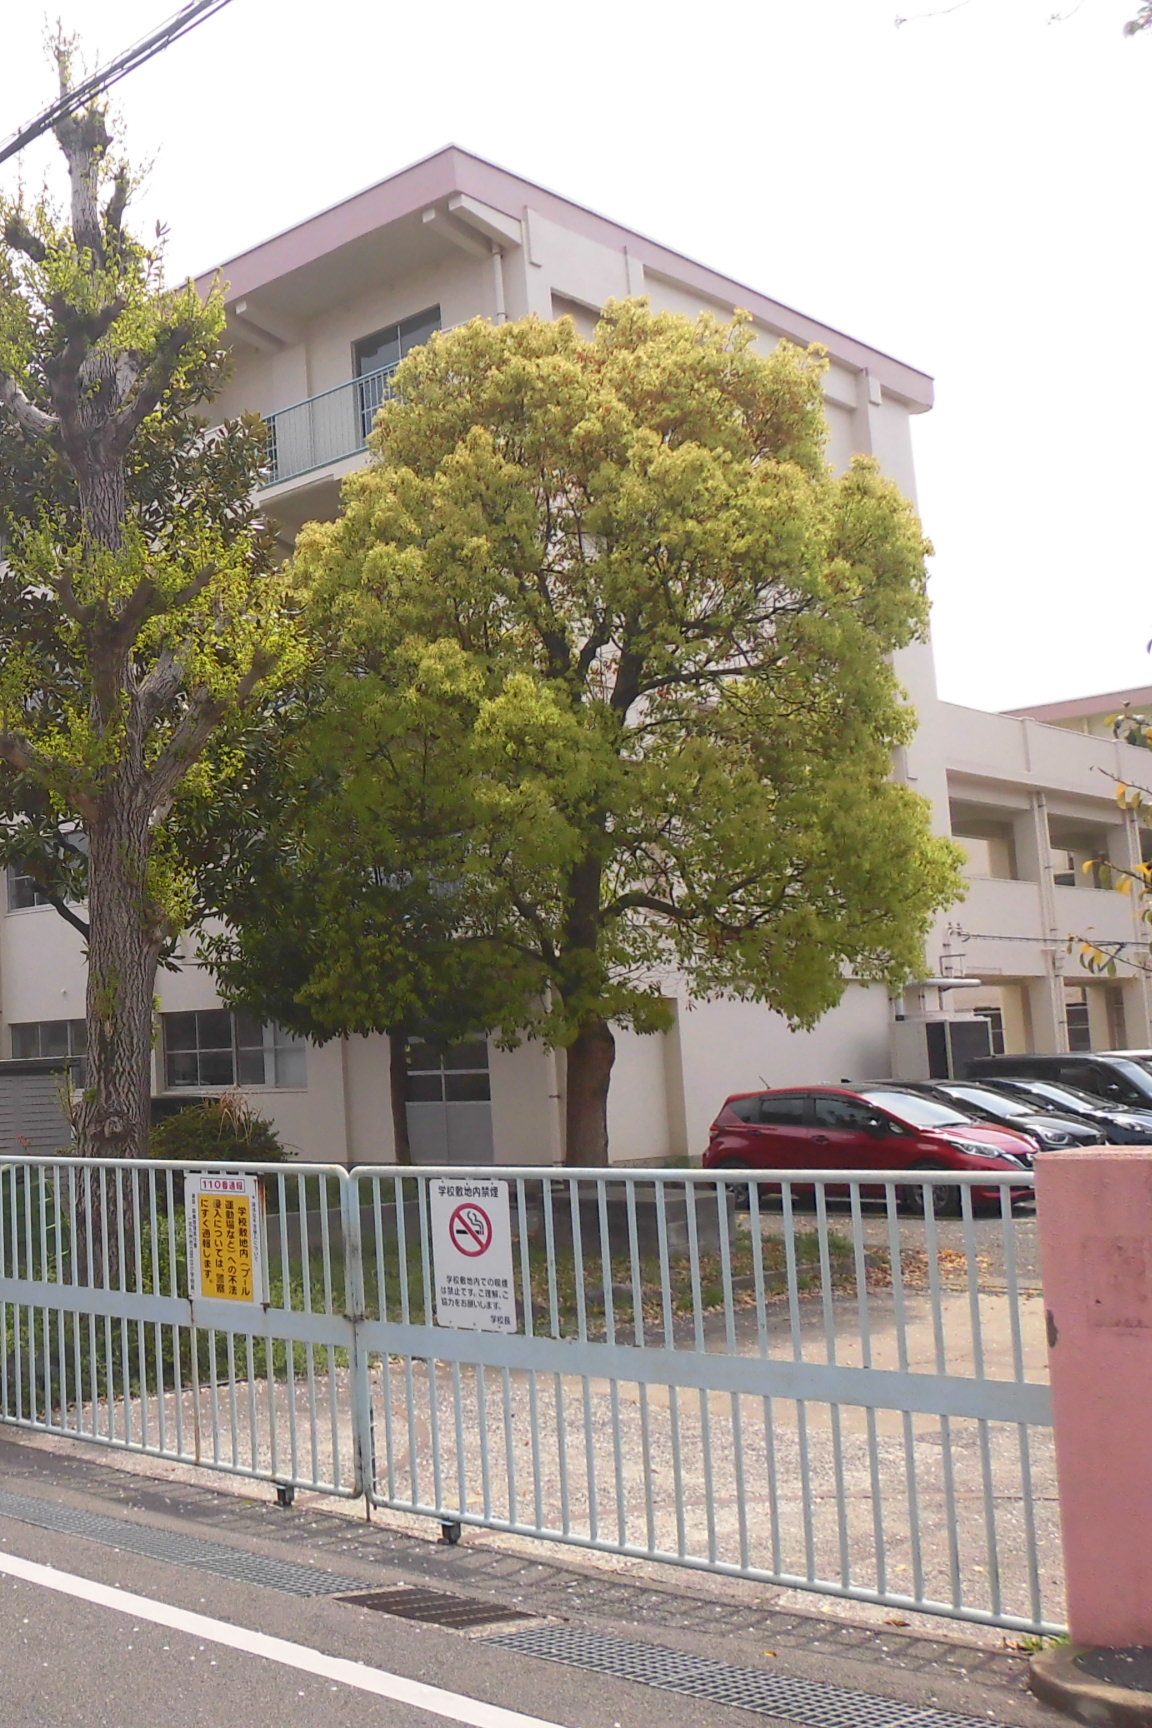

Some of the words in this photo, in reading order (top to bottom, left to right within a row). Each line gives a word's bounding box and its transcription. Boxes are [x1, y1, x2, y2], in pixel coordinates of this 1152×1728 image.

[202, 1180, 243, 1190] 110番通報
[438, 1185, 499, 1198] 学校敷地内禁煙
